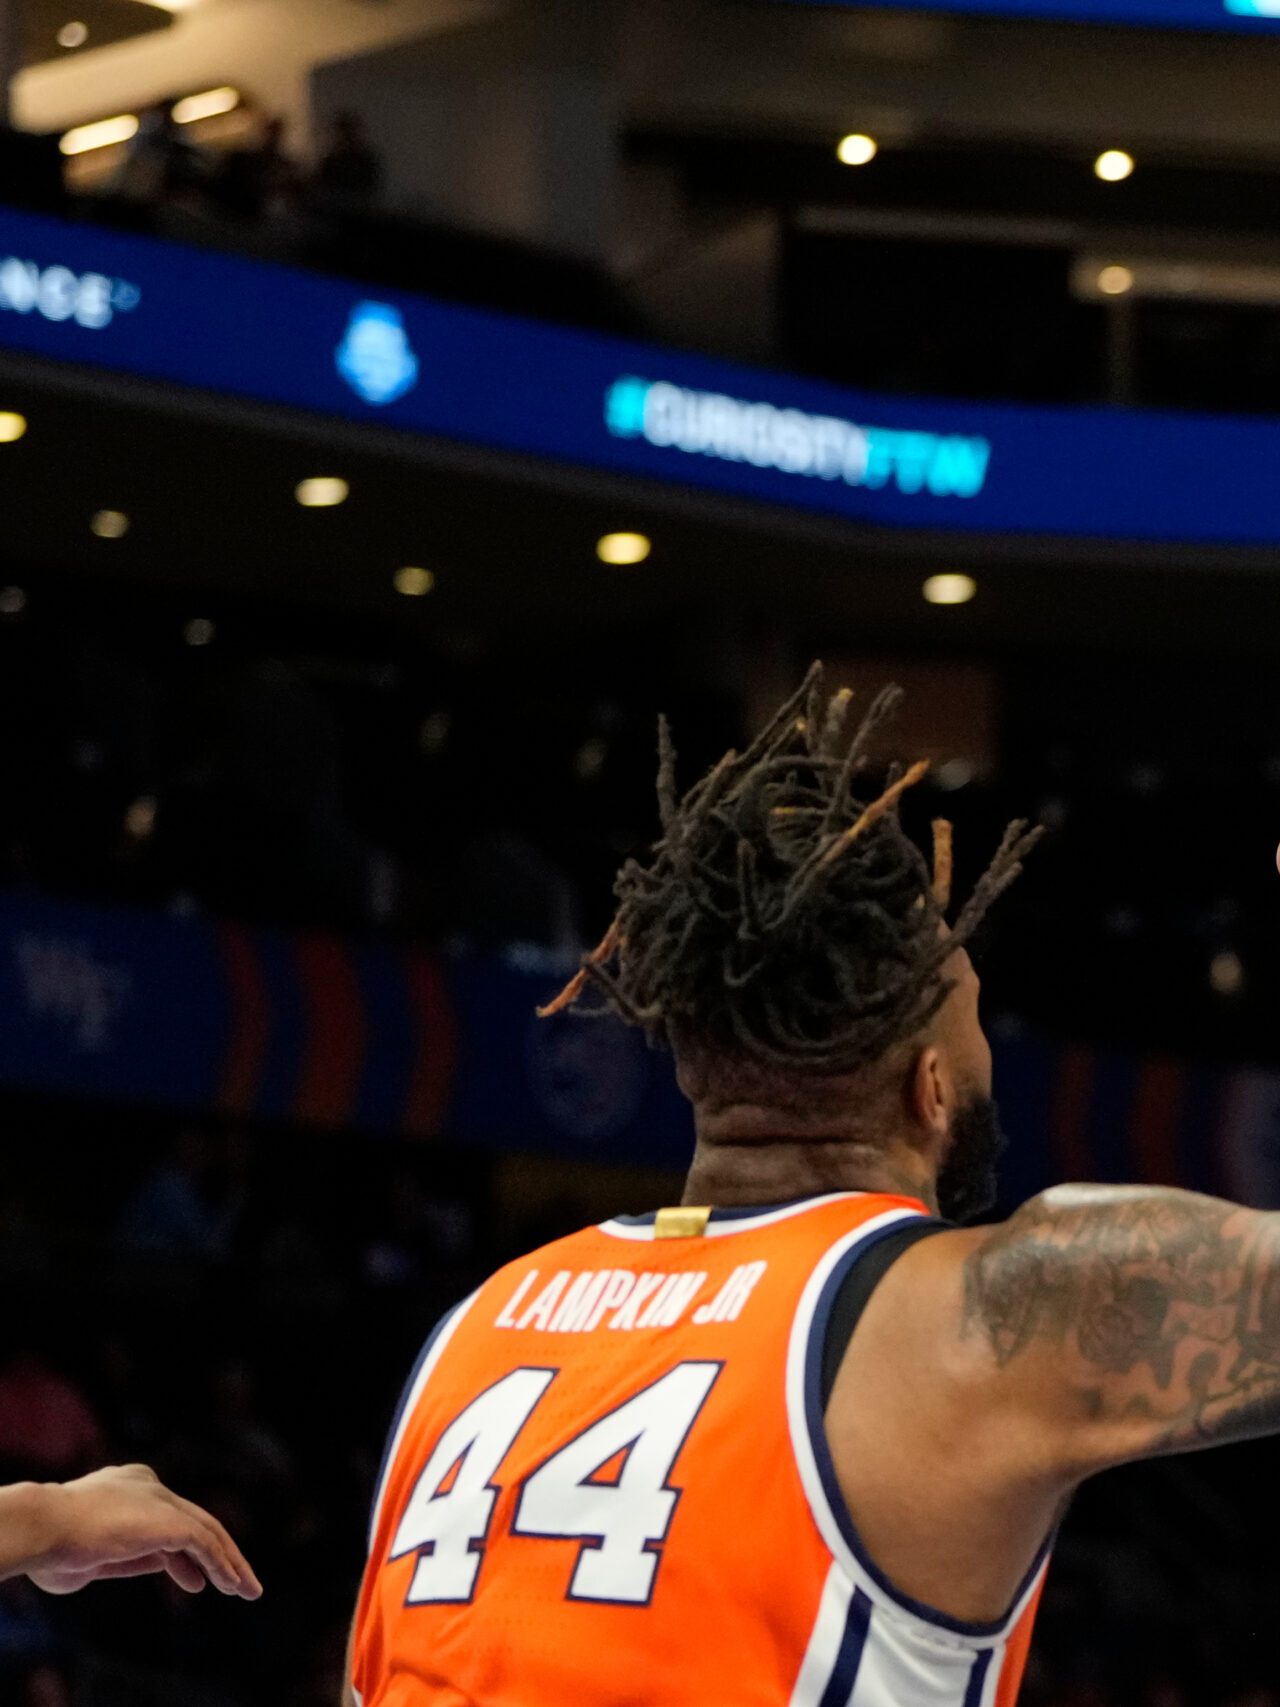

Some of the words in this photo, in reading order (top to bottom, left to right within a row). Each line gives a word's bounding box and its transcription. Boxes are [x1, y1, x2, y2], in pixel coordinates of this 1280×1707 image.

[494, 1269, 708, 1332] LAMPKIN
[692, 1260, 768, 1324] JR
[386, 1359, 726, 1608] 44
